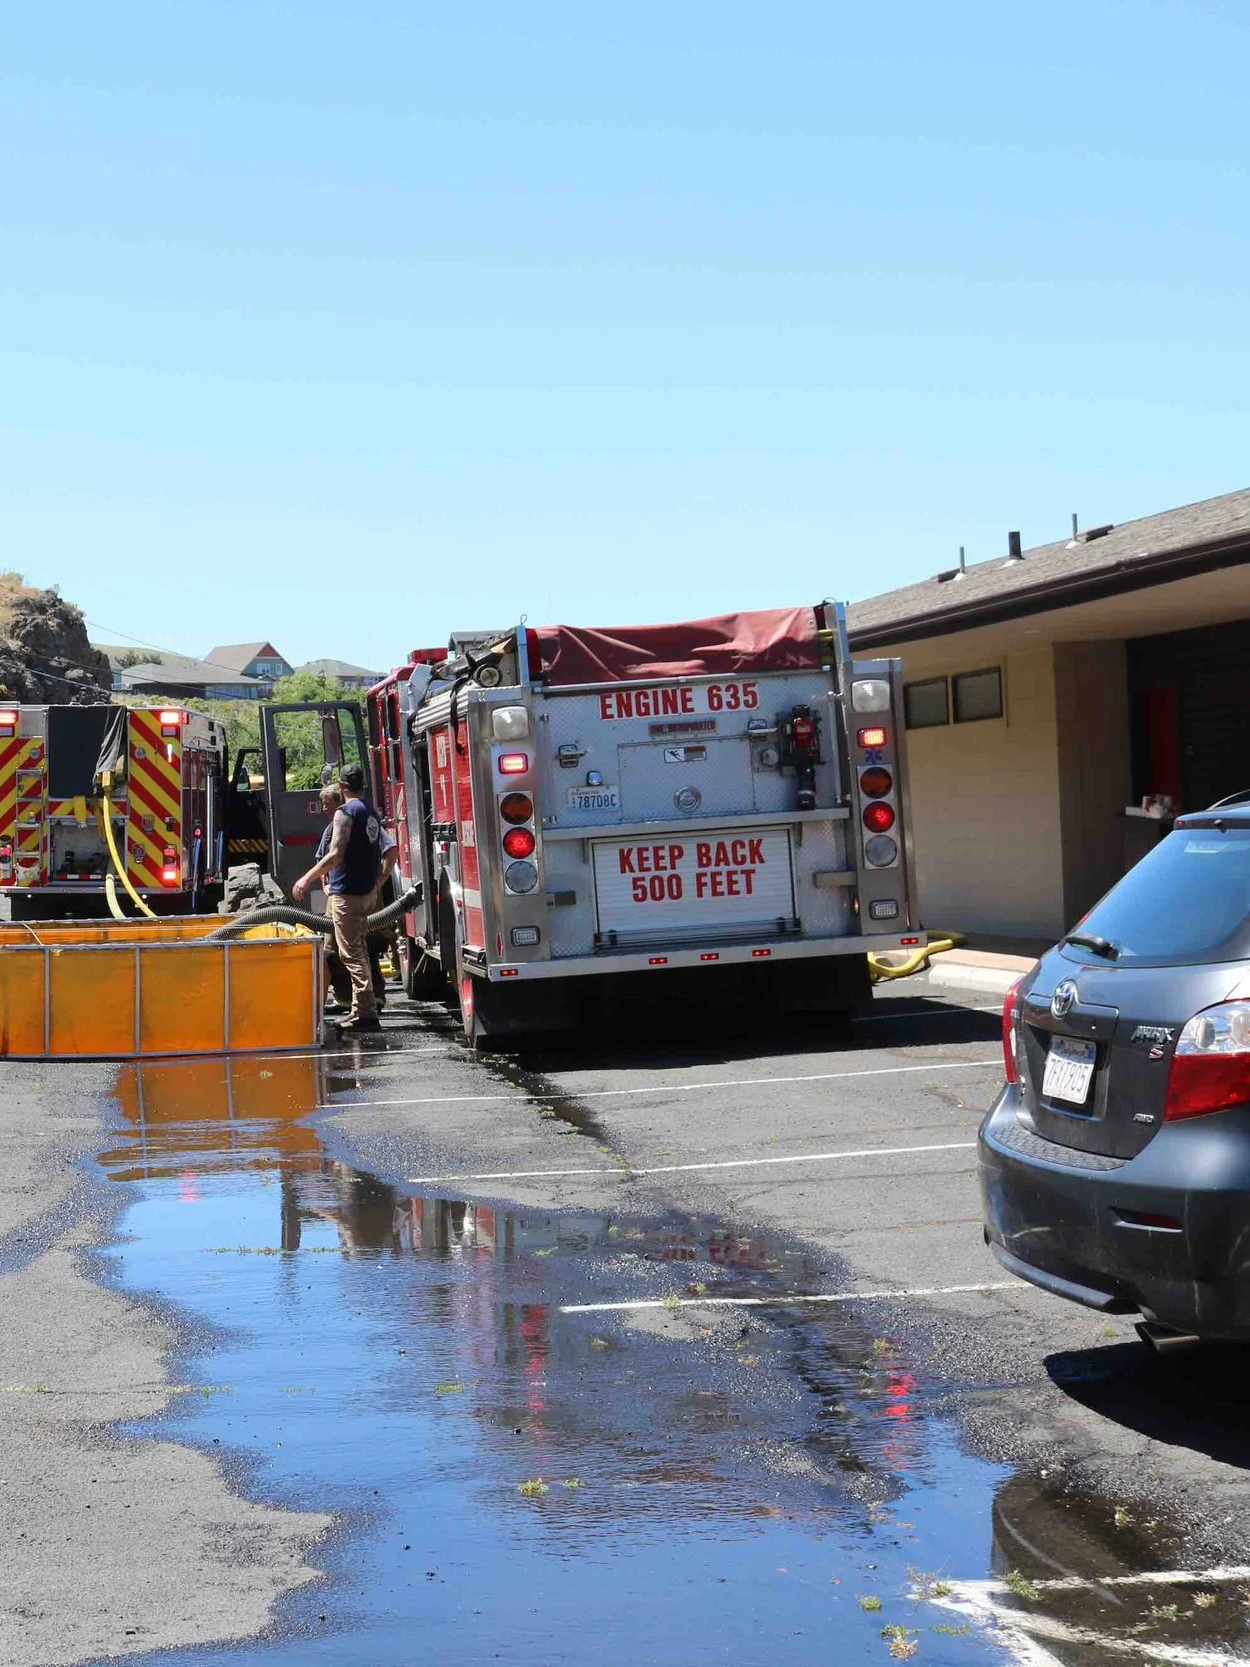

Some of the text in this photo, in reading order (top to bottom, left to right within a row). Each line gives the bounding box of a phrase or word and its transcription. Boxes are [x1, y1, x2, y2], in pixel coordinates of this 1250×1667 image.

[600, 682, 758, 720] ENGINE 635
[618, 839, 766, 874] KEEP BACK
[631, 868, 756, 903] 500 FEET
